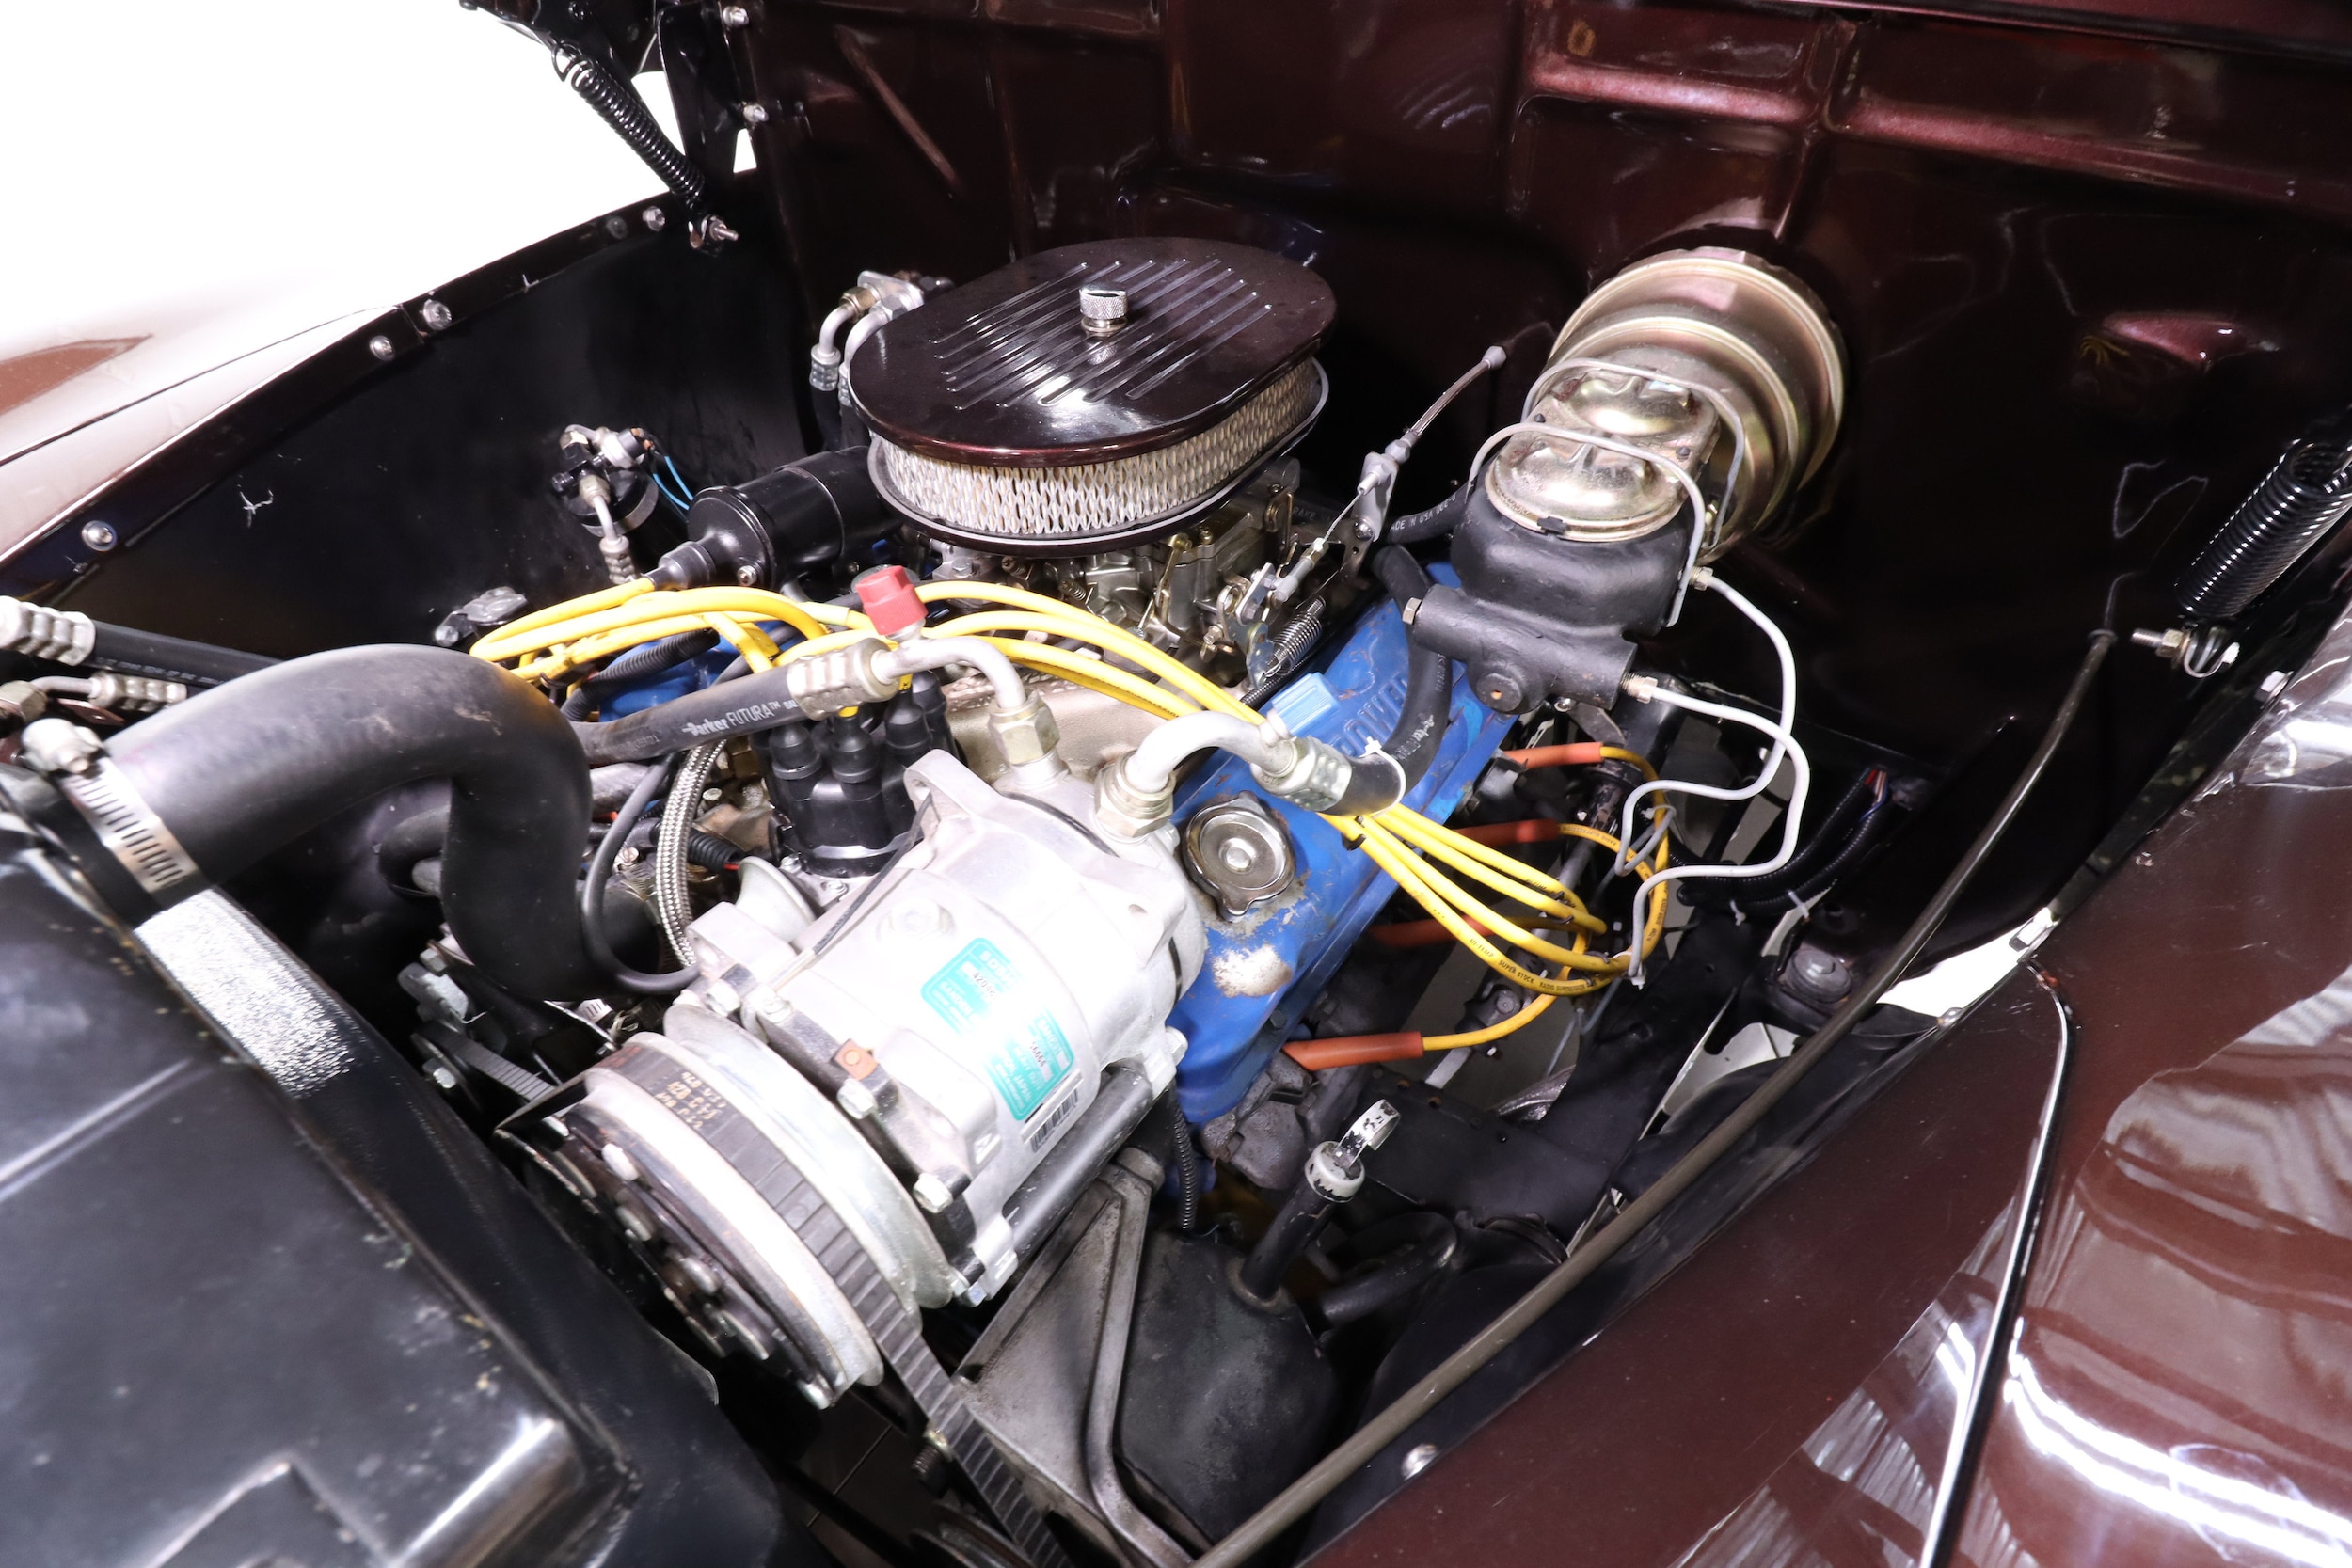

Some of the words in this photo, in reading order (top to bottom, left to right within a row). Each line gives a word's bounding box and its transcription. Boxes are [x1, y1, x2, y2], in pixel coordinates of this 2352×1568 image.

[681, 718, 730, 736] Parker
[1470, 938, 1495, 958] HI-TEMP
[1498, 958, 1517, 975] SUPER
[1517, 971, 1535, 985] STOCK
[1539, 981, 1556, 991] RADIO
